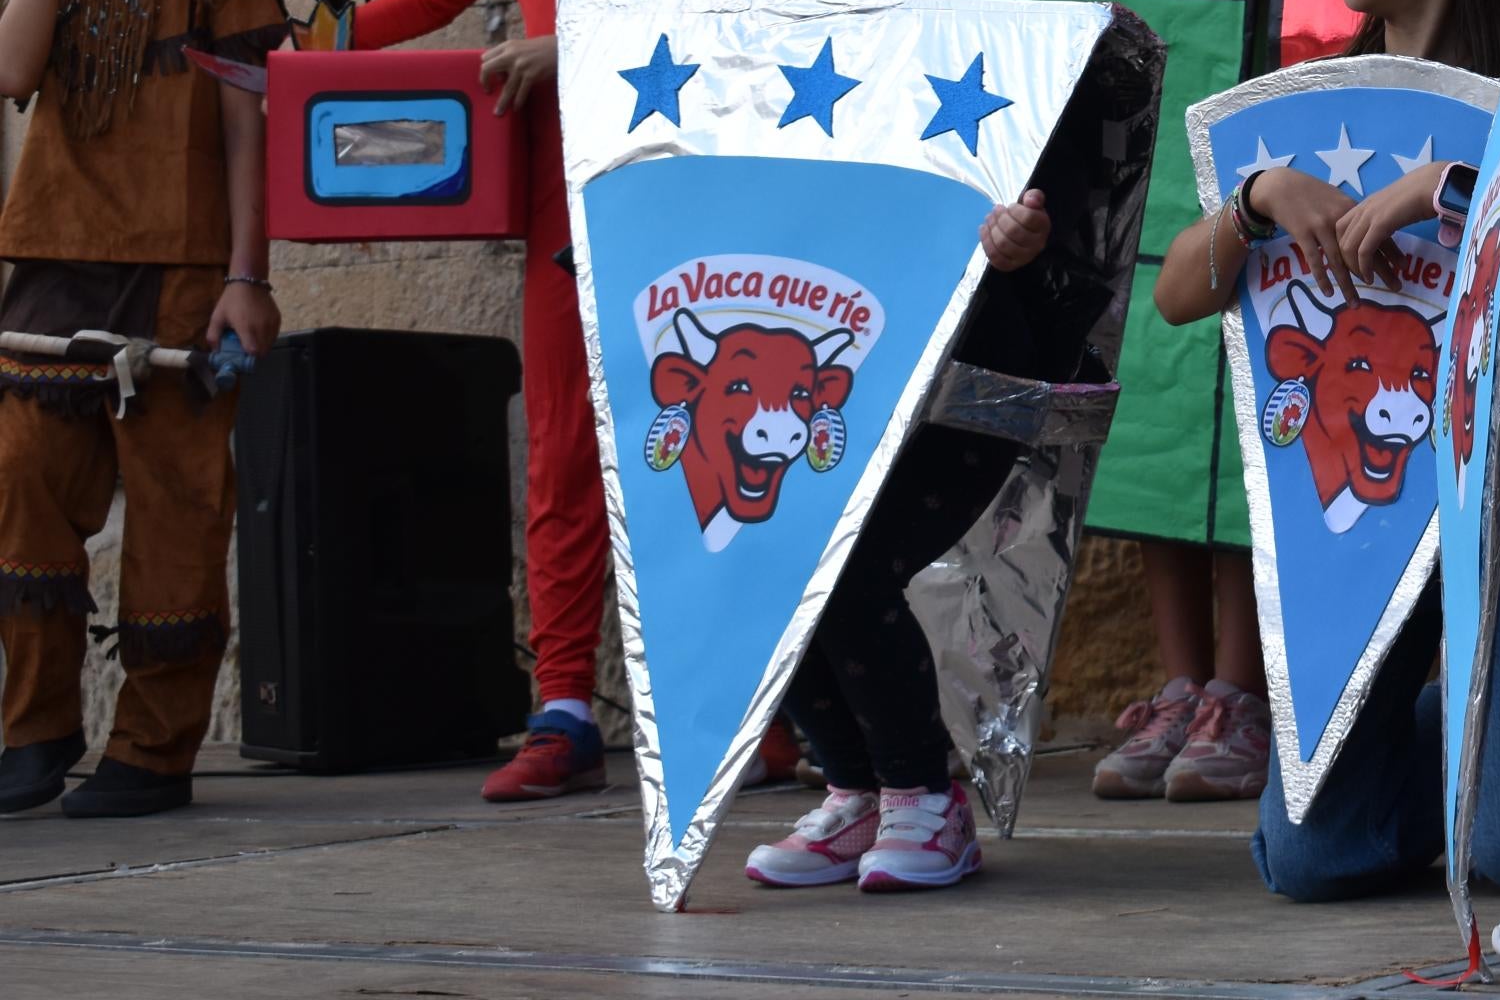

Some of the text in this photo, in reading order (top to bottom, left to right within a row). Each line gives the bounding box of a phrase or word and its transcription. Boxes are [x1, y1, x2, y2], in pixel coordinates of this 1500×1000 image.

[648, 285, 680, 322] La
[680, 262, 763, 303] Vaca
[768, 274, 828, 311] que
[1261, 253, 1292, 292] La
[1394, 253, 1442, 290] ue
